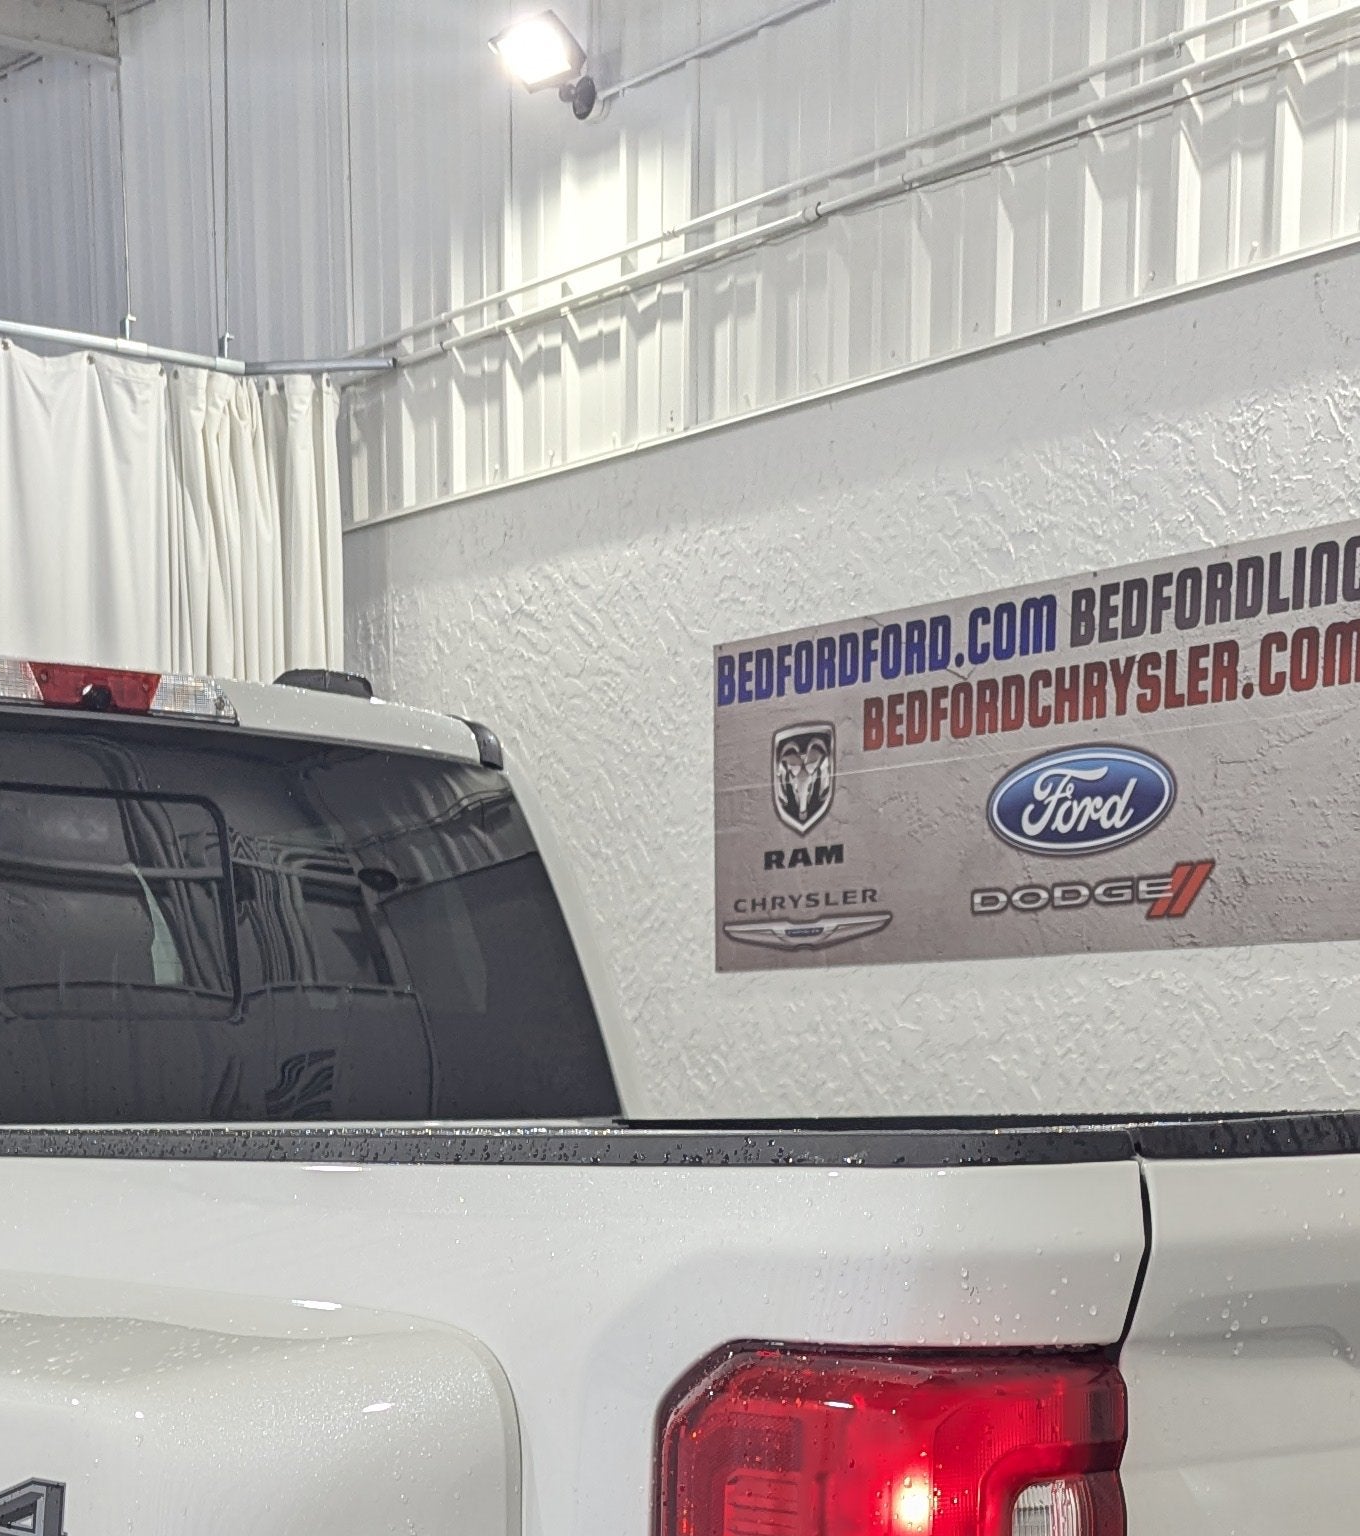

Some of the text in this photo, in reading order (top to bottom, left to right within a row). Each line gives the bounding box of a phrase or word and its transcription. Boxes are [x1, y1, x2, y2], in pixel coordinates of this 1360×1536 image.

[716, 593, 1058, 708] BEDFORDFORD.COM
[1020, 765, 1138, 837] Ford
[763, 843, 845, 871] RAM
[733, 888, 879, 914] CHRYSLER
[971, 873, 1174, 915] DODGE
